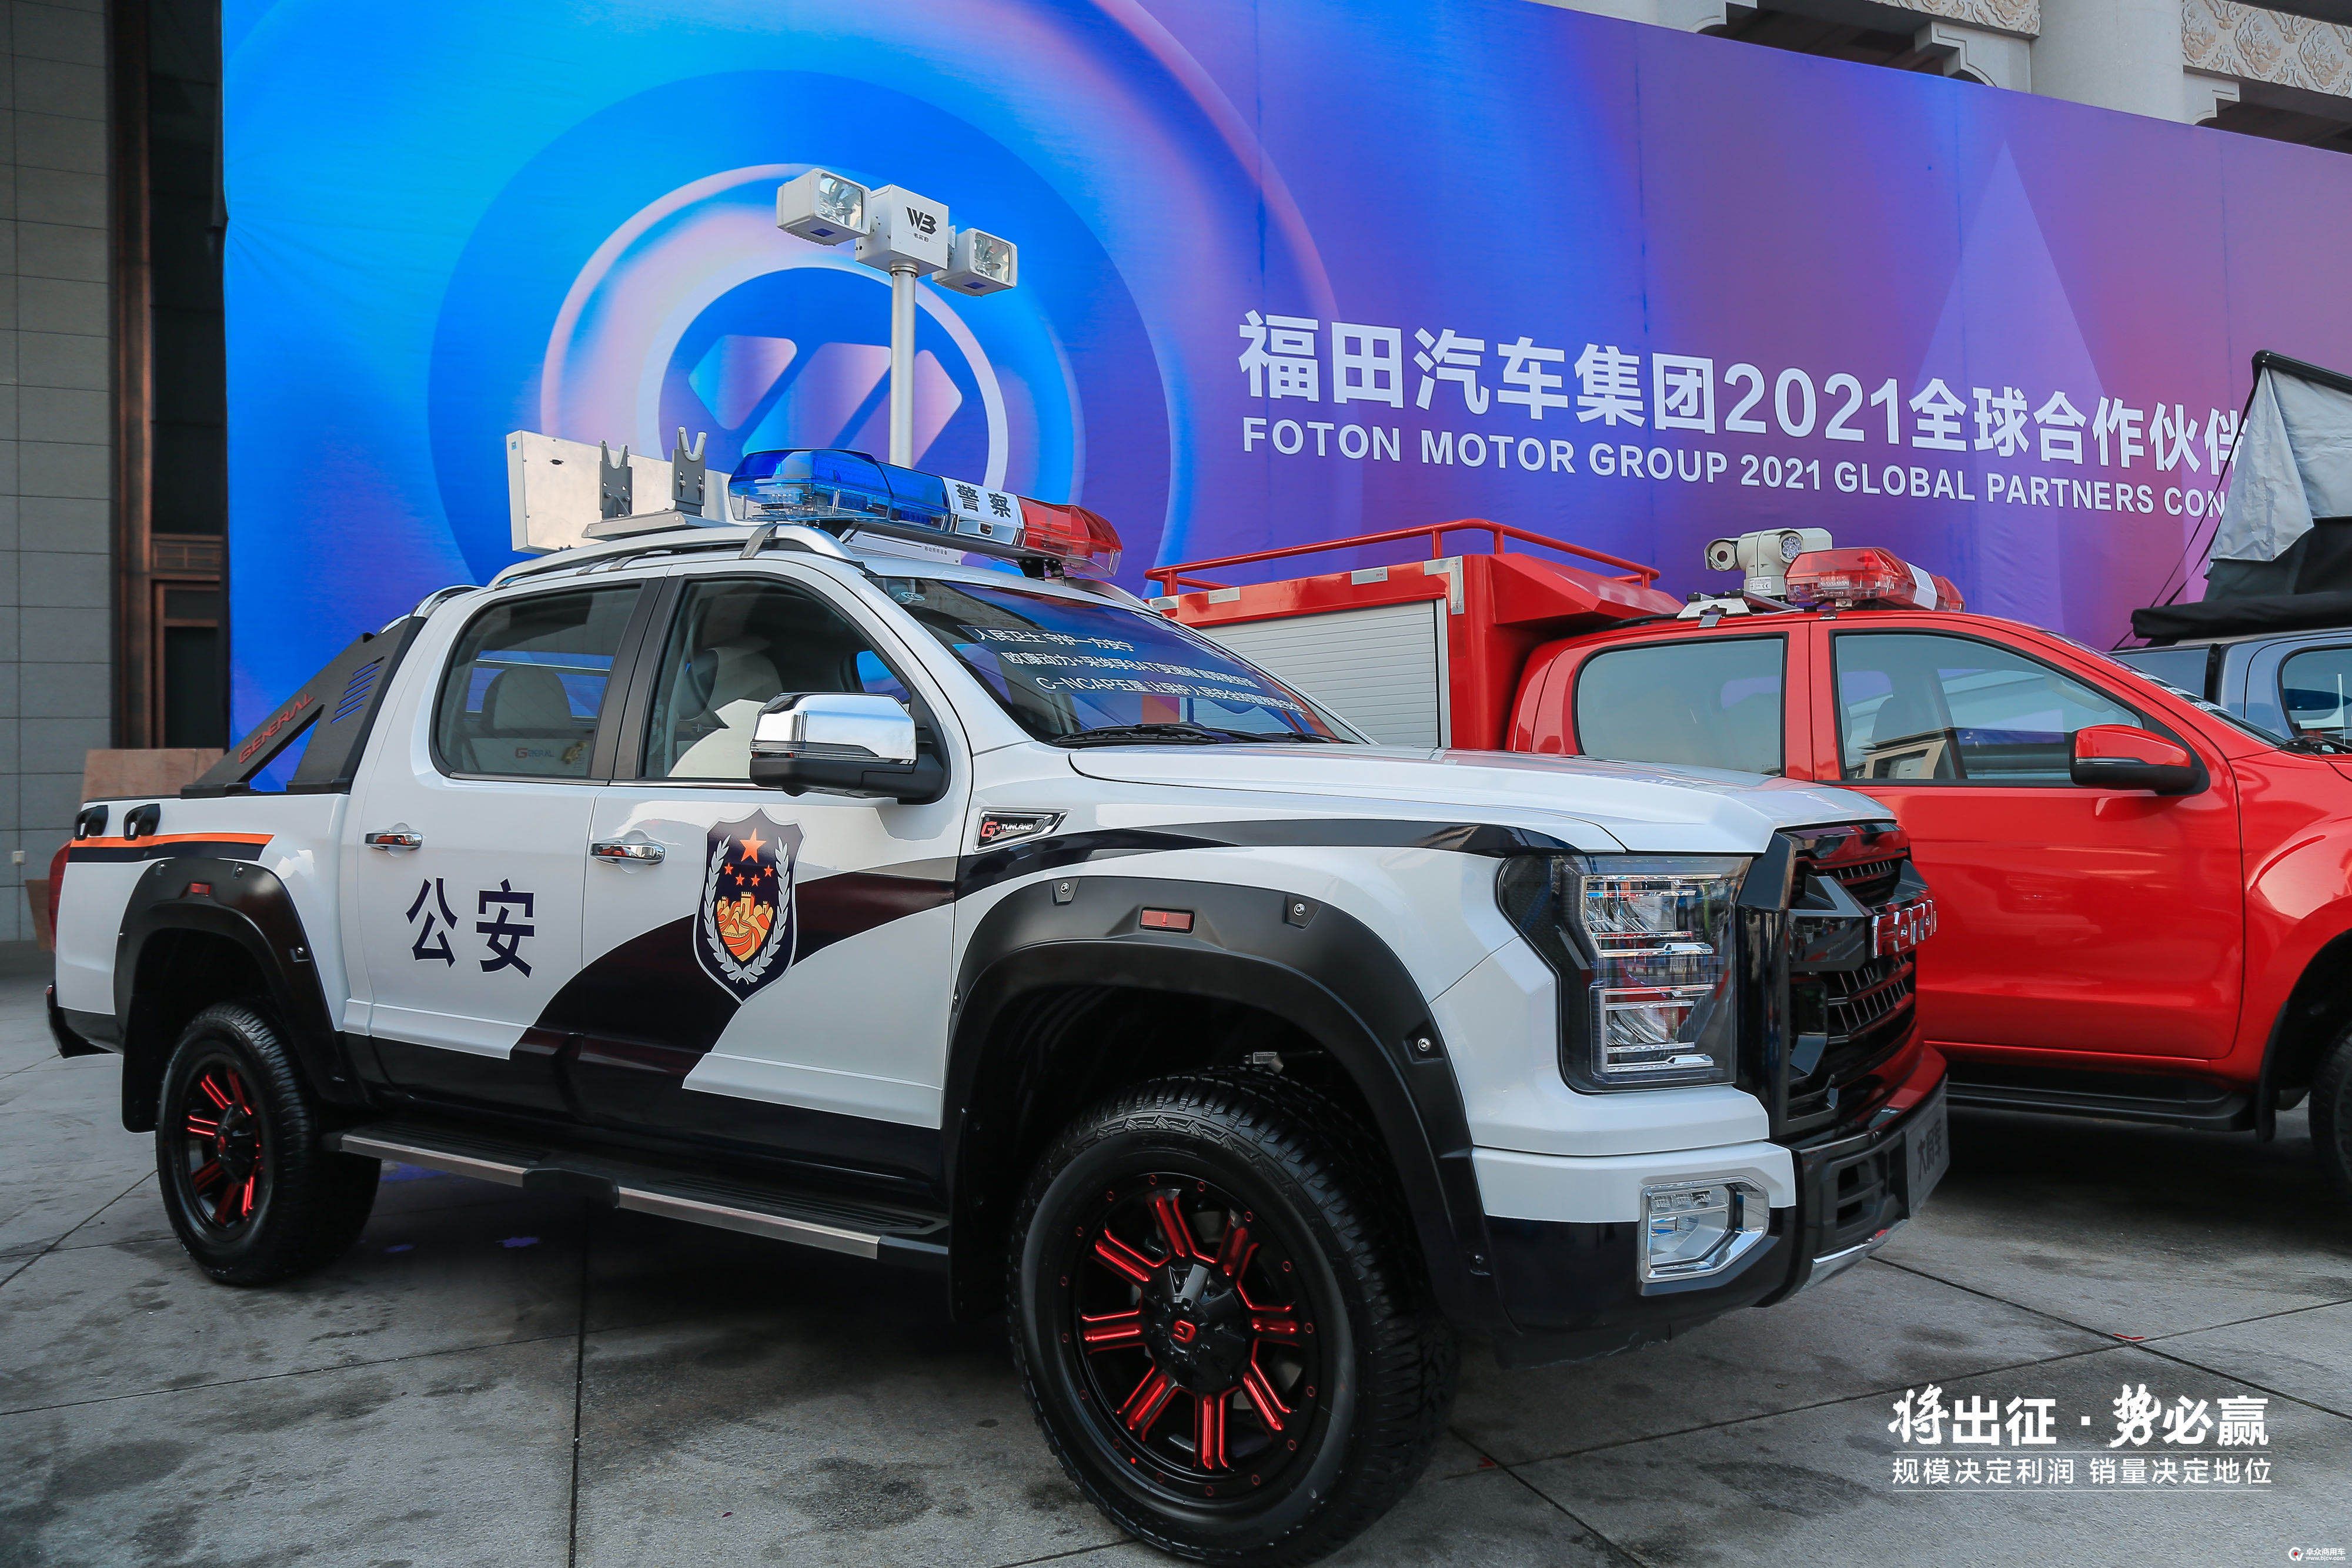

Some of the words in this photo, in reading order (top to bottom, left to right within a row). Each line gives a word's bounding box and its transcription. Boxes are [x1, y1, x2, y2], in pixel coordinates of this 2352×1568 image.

[1238, 309, 2249, 476] 福田汽车集团2021全球合作伙伴
[1243, 416, 1401, 462] FOTON
[1421, 429, 1576, 474] MOTOR
[1589, 443, 1729, 484] GROUP
[1740, 453, 1821, 491] 2021
[1833, 460, 1976, 502] GLOBAL
[1986, 472, 2155, 514] PARTNERS
[954, 483, 1011, 519] 警察
[974, 628, 1047, 643] 人民卫士
[1042, 632, 1135, 652] 守护一方安宁
[239, 693, 315, 764] GENERAL
[1001, 823, 1034, 831] TUNLAND
[405, 877, 536, 978] 公安
